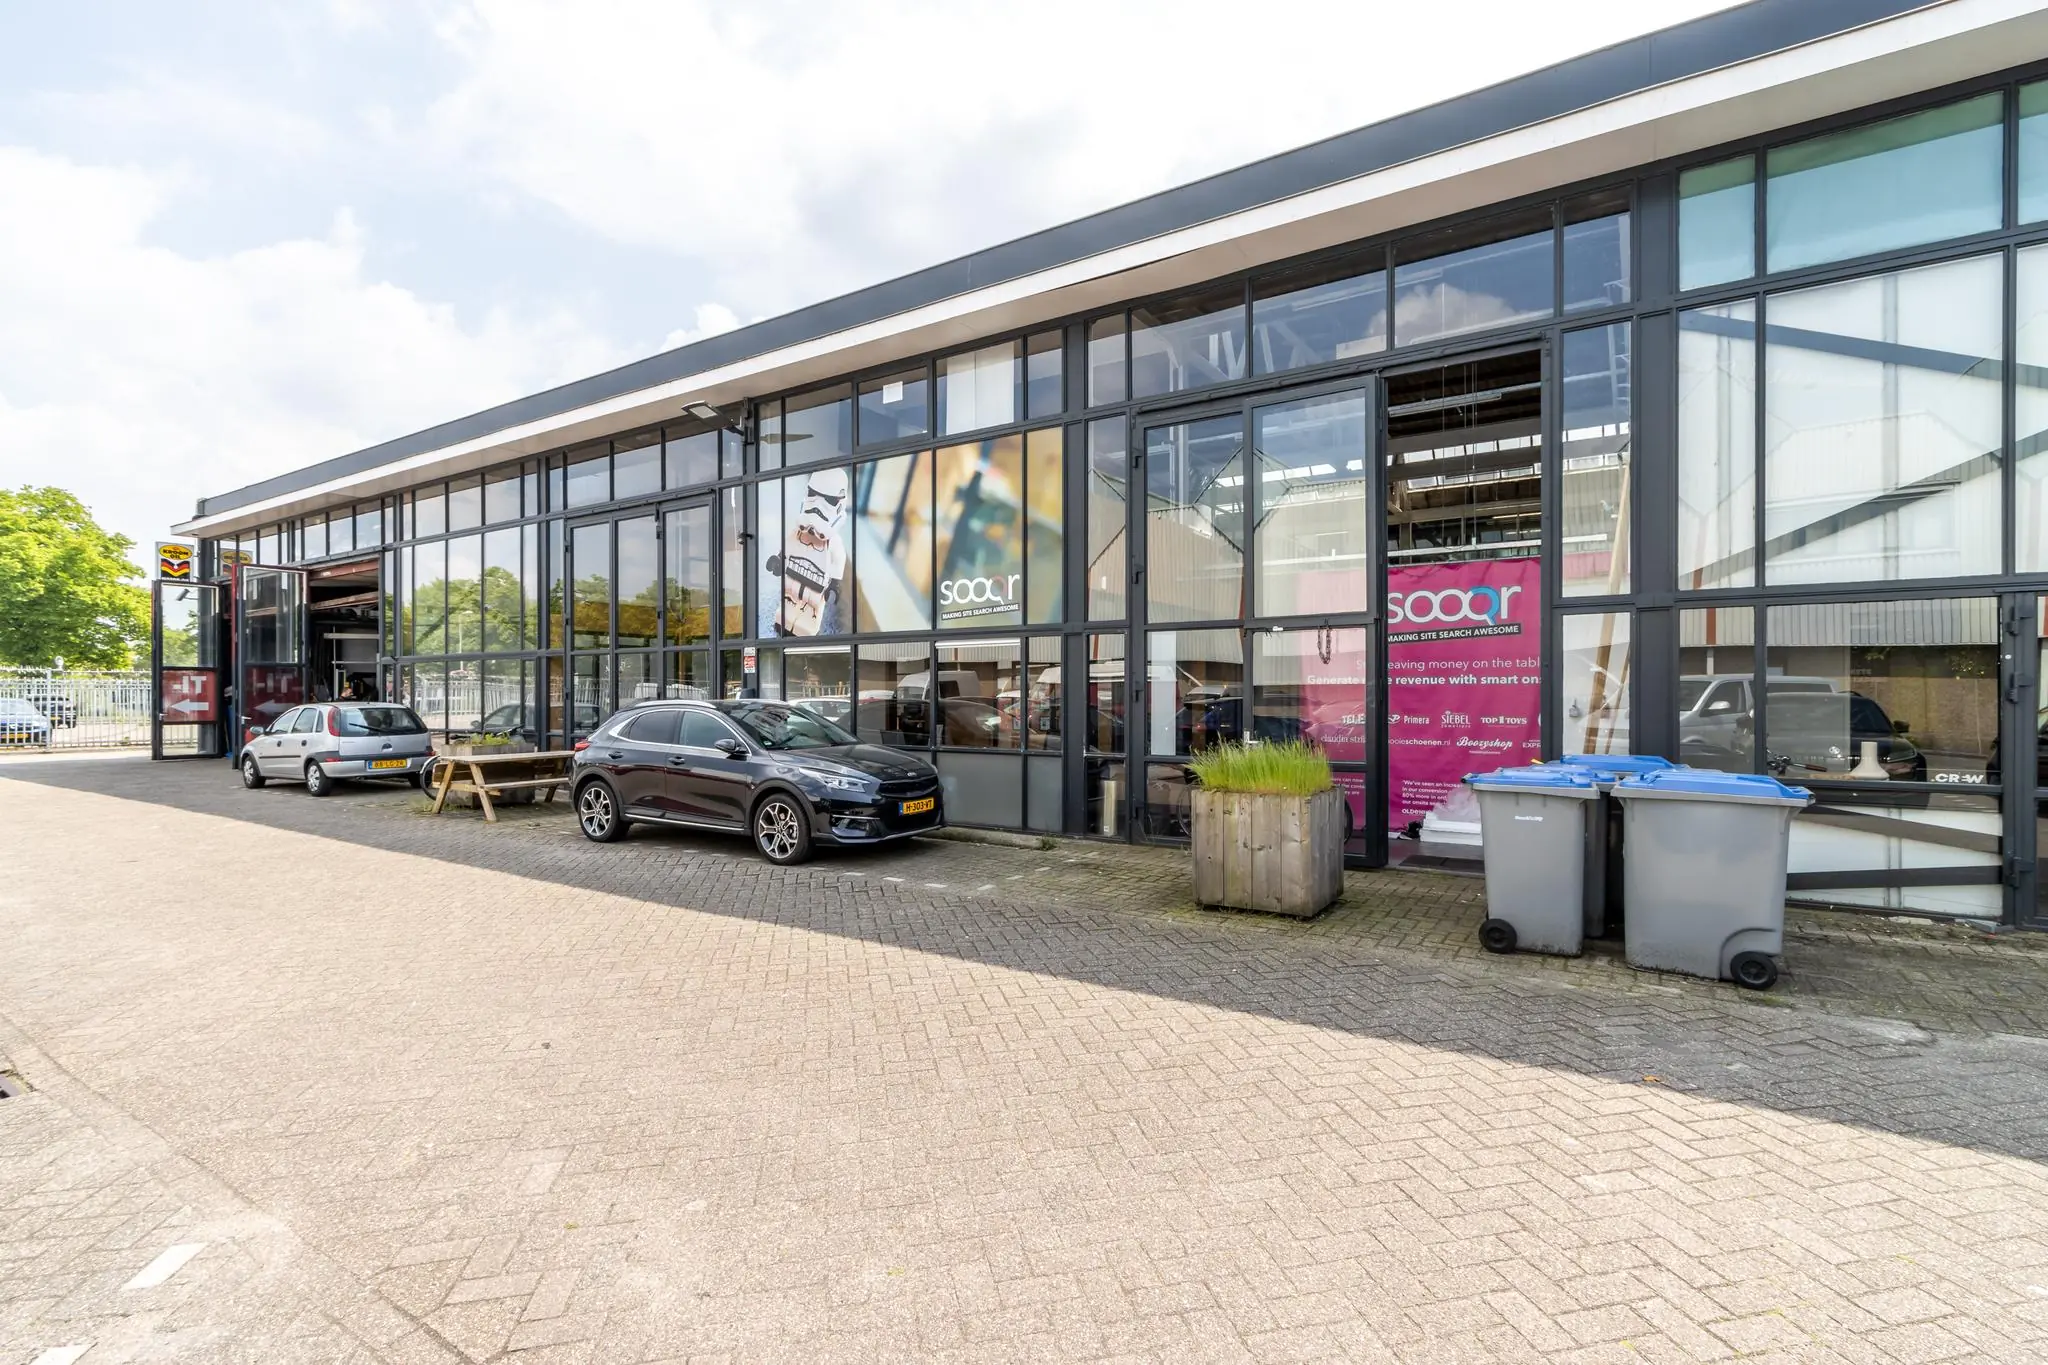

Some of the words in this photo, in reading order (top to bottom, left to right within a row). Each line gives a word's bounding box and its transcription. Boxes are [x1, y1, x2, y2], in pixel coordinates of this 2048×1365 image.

[942, 611, 962, 620] MAKING
[962, 609, 973, 617] SITE
[973, 607, 993, 616] SEARCH
[993, 603, 1019, 613] AWESOME
[1420, 631, 1437, 640] SITE
[1439, 628, 1472, 639] SEARCH
[1474, 625, 1519, 636] AWESOME
[1388, 658, 1425, 672] eaving
[1428, 660, 1469, 672] money
[1472, 660, 1488, 669] on
[1492, 657, 1512, 668] the
[1516, 656, 1540, 668] tabl
[1307, 674, 1360, 685] Generate
[1395, 676, 1446, 686] revenue
[1449, 674, 1477, 685] with
[1480, 674, 1518, 685] smart
[1403, 715, 1430, 725] Primera
[1441, 713, 1471, 725] SIEBEL
[1480, 716, 1498, 725] TOP
[1505, 716, 1528, 725] TOYS
[1456, 736, 1513, 750] Boozyshop
